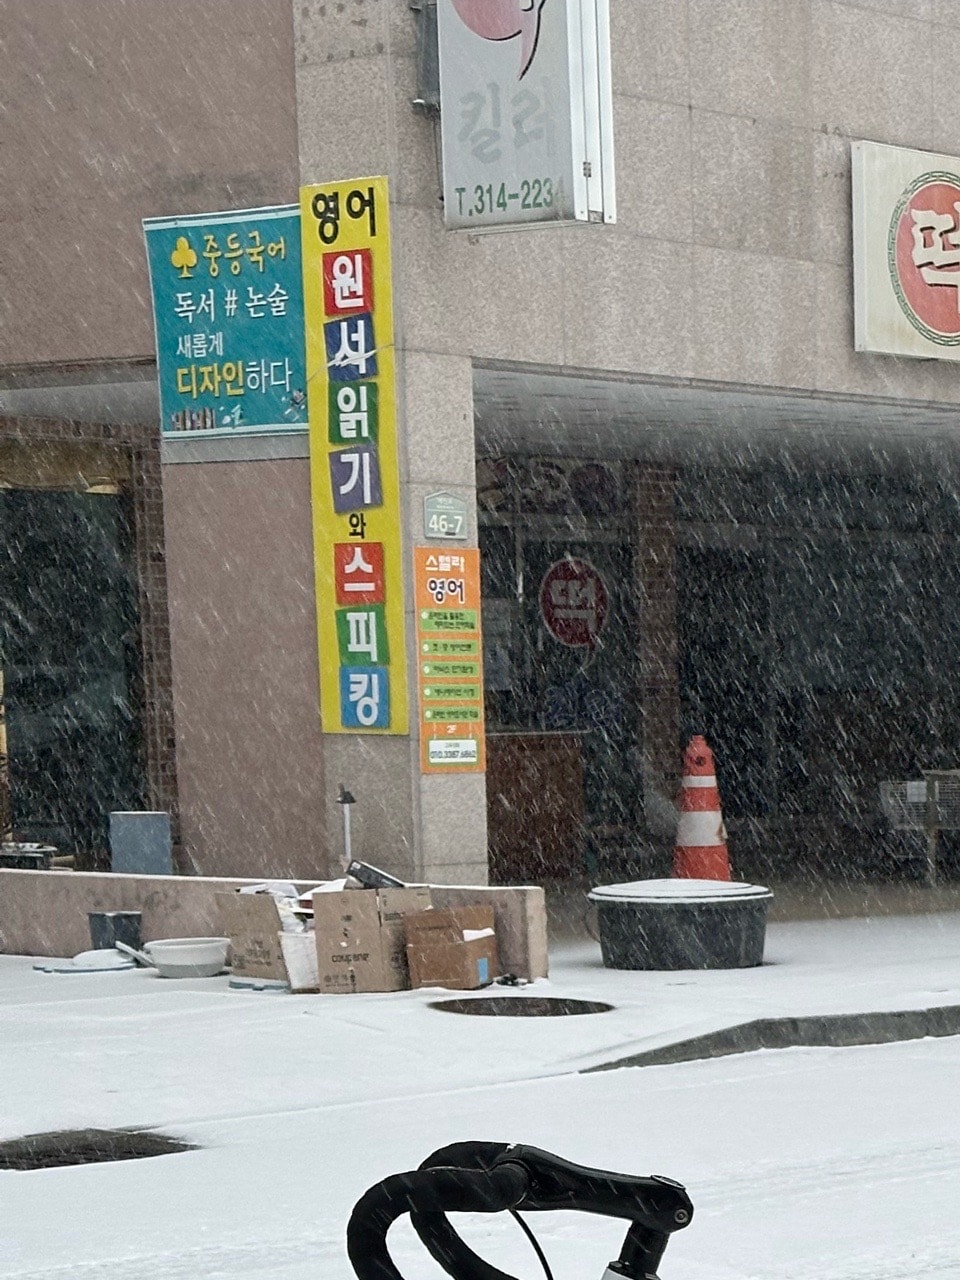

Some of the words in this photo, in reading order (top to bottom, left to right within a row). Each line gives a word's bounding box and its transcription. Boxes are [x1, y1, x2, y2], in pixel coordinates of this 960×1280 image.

[311, 187, 377, 245] 영어
[202, 230, 287, 278] 중등국어
[174, 290, 215, 323] 독서
[245, 283, 289, 317] 논술
[176, 332, 224, 359] 새롭게
[176, 356, 293, 399] 디자인하다
[428, 514, 463, 534] 46-7
[428, 578, 465, 603] 영어
